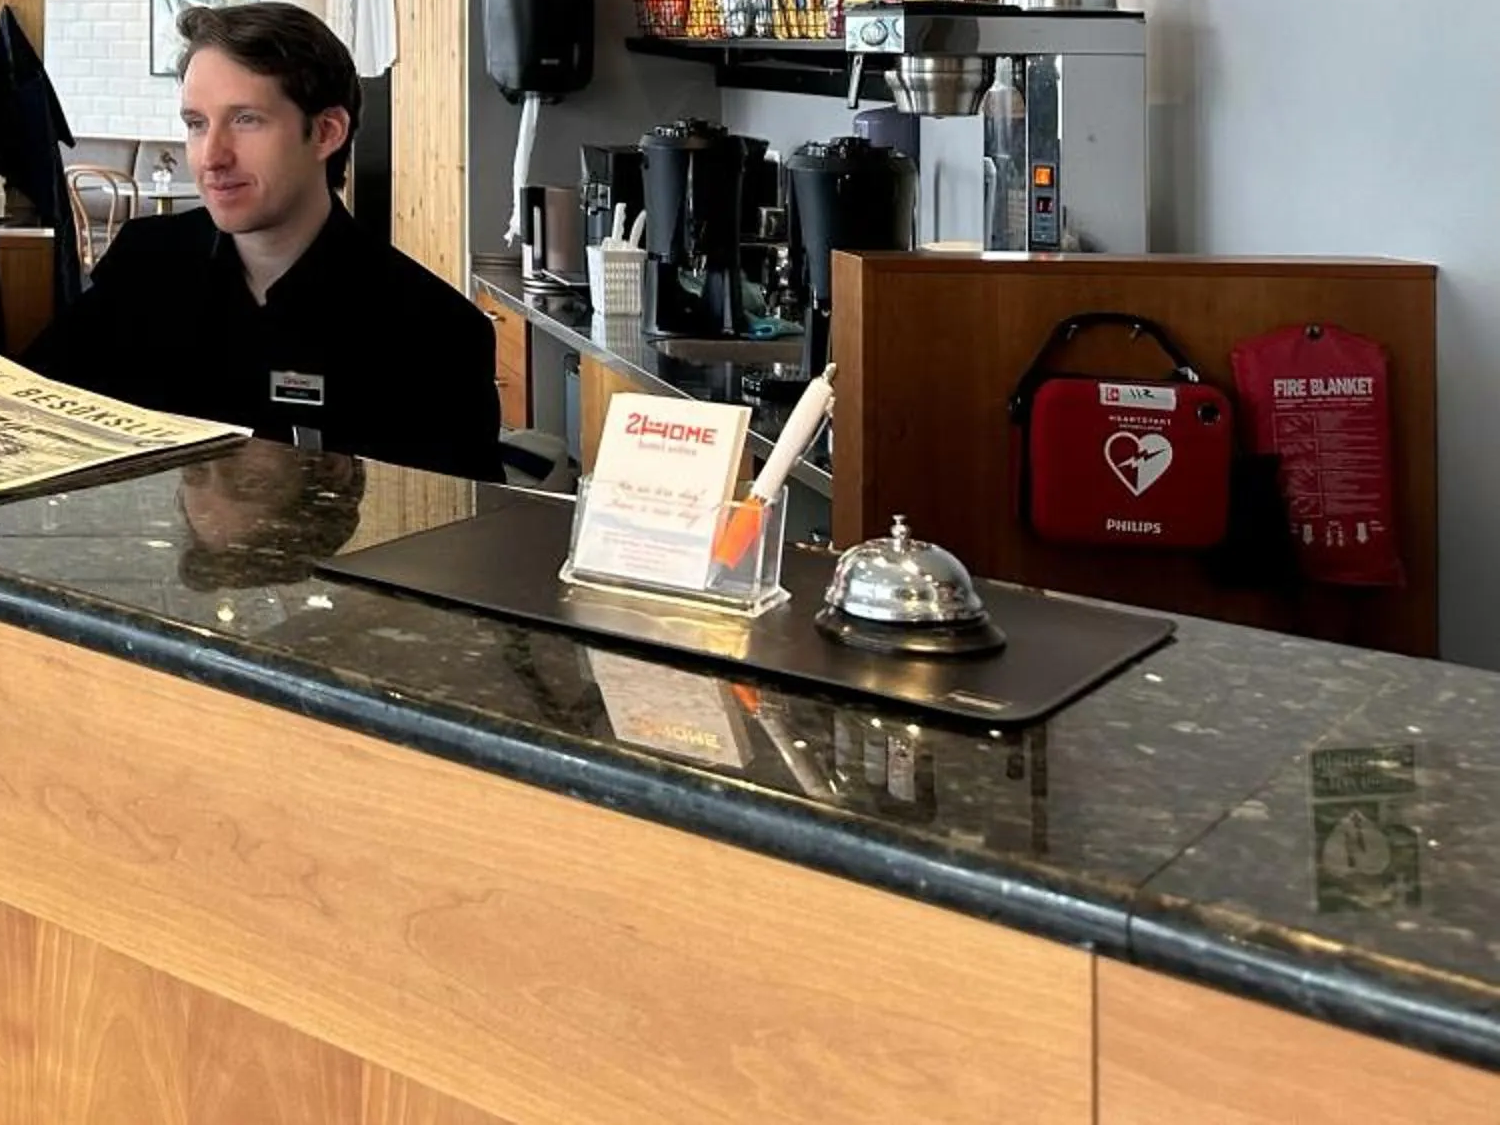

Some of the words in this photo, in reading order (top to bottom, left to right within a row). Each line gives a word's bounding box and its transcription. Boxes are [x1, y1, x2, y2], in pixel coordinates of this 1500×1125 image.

[1273, 378, 1307, 397] FIRE
[1309, 377, 1374, 396] BLANKET
[1106, 518, 1162, 534] PHILIPS
